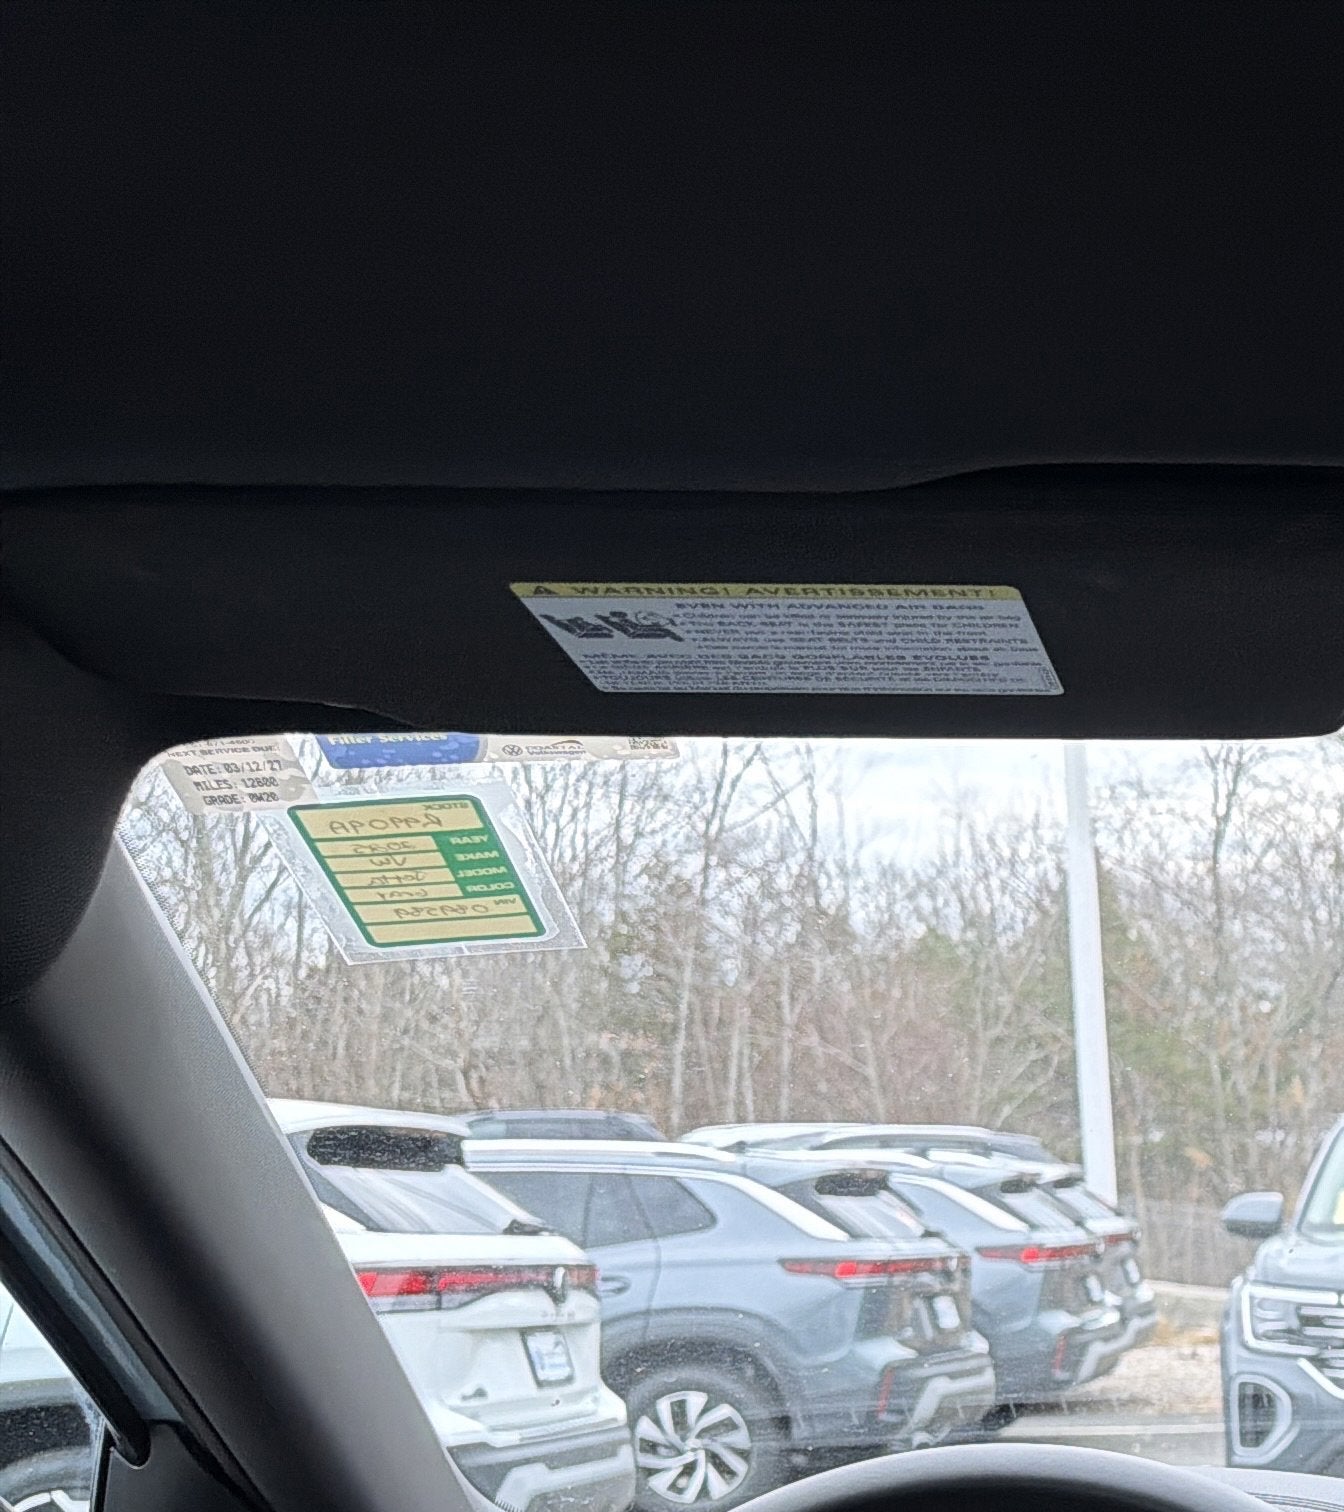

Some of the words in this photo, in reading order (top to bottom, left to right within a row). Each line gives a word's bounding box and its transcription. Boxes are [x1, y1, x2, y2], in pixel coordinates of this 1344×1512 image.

[571, 586, 730, 596] WARNING!
[746, 586, 998, 598] AVERTISSEMENT!
[200, 746, 250, 757] SERVICE
[183, 762, 221, 776] DATE:
[223, 759, 282, 774] 03/12/27
[192, 778, 238, 792] MILES:
[202, 793, 246, 807] GRADE:
